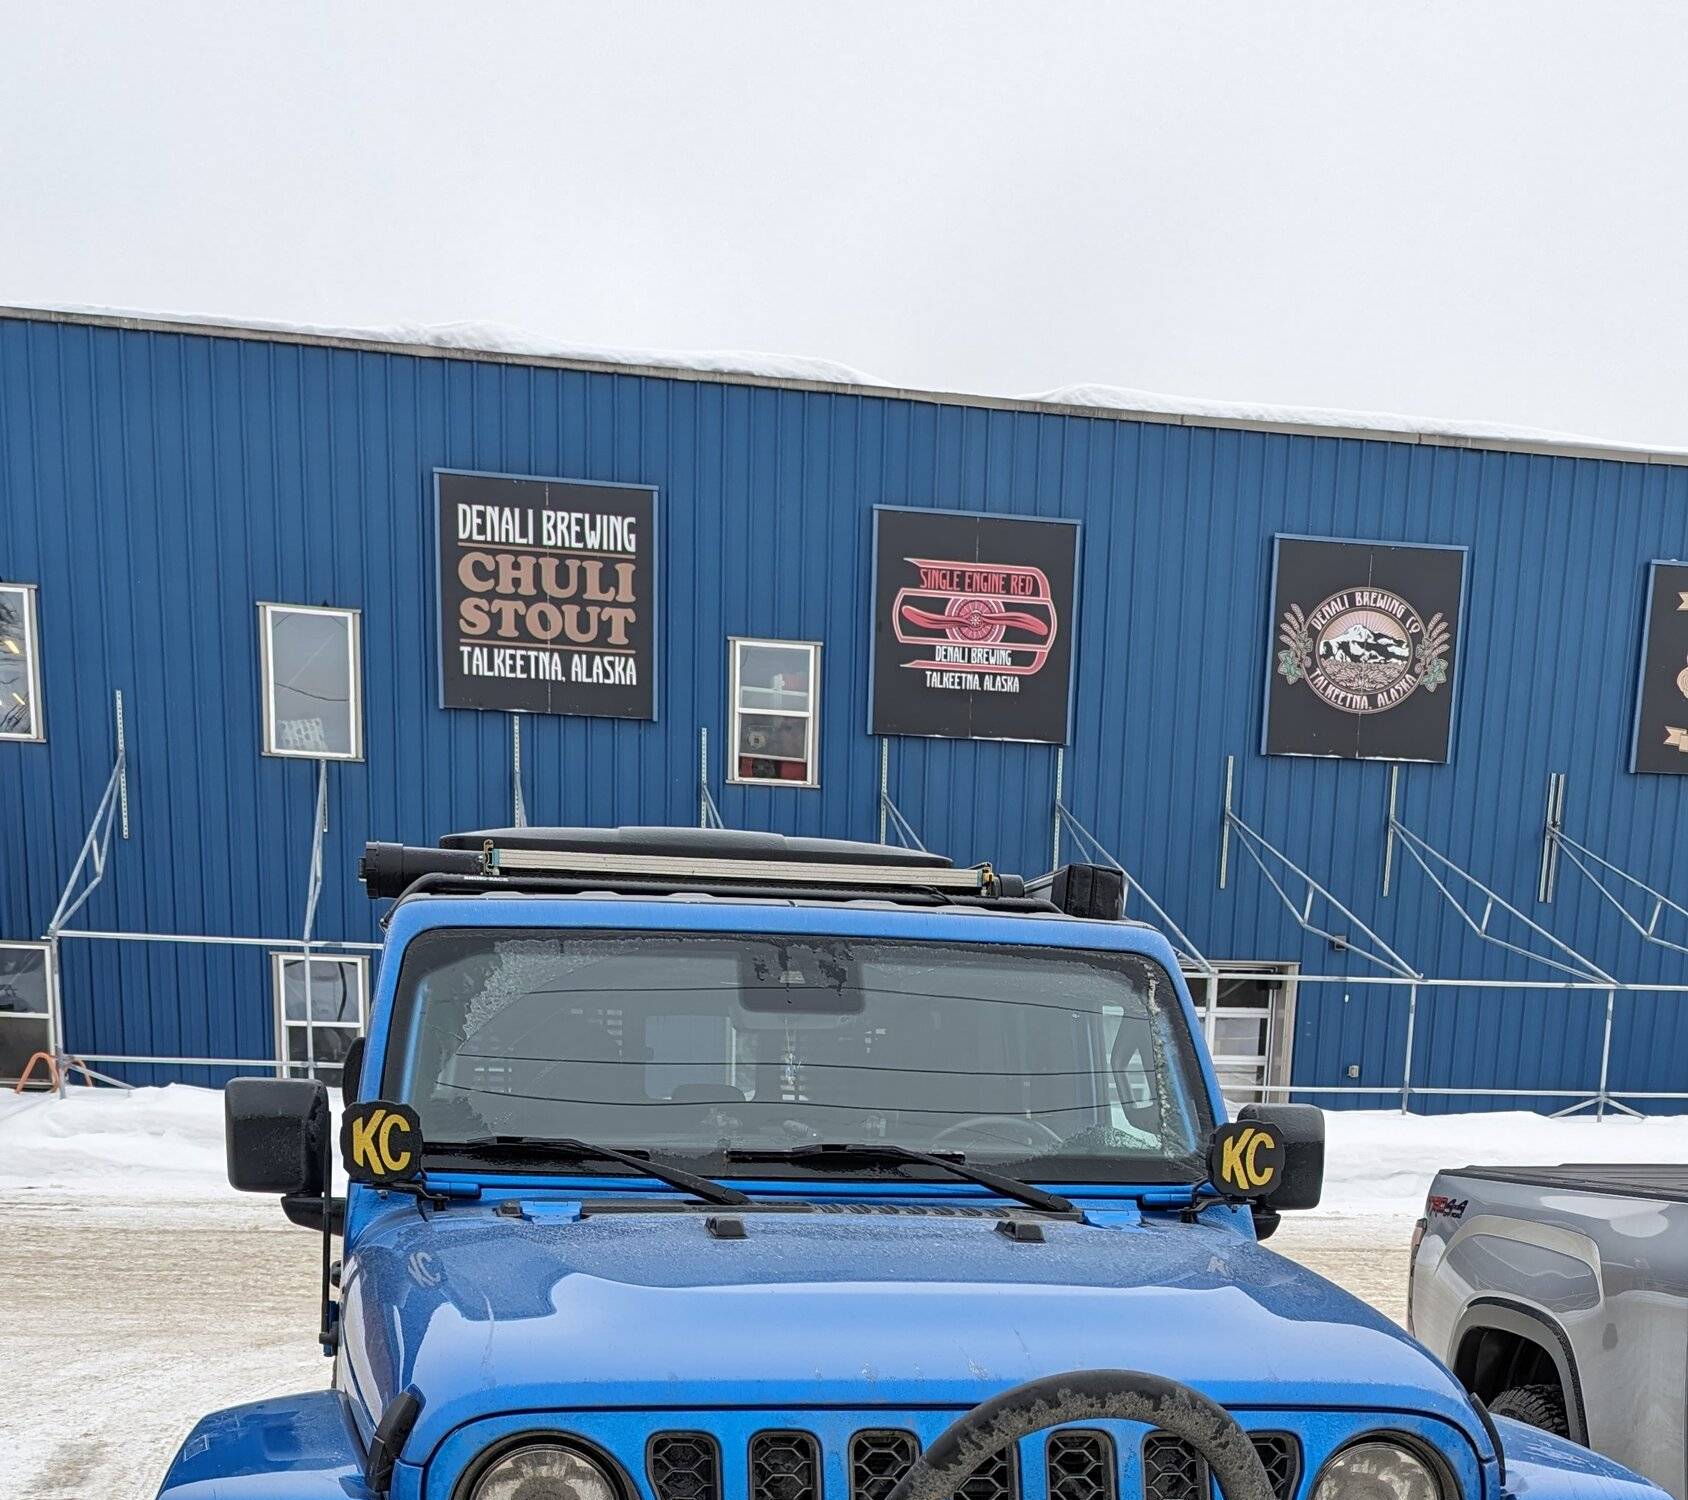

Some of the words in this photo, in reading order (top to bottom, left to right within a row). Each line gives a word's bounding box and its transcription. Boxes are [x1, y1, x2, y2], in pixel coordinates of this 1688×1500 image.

[457, 503, 534, 545] DENALI
[542, 509, 636, 552] BREWING
[457, 552, 636, 603] CHULI
[919, 569, 961, 590] SINGLE
[964, 571, 1006, 594] ENGINE
[1010, 575, 1034, 596] RED
[459, 597, 636, 645] STOUT
[1311, 594, 1349, 631] DENALI
[1355, 592, 1407, 618] BREWING
[459, 646, 566, 682] TALKEETNA,
[571, 654, 637, 686] ALASKA
[935, 645, 968, 663] DENALI
[971, 648, 1012, 666] BREWING
[983, 675, 1020, 693] ALASKA
[1308, 668, 1373, 710] TALKEETNA,
[1376, 673, 1417, 708] ALASKA
[352, 1109, 411, 1175] KC
[1222, 1128, 1275, 1190] KC
